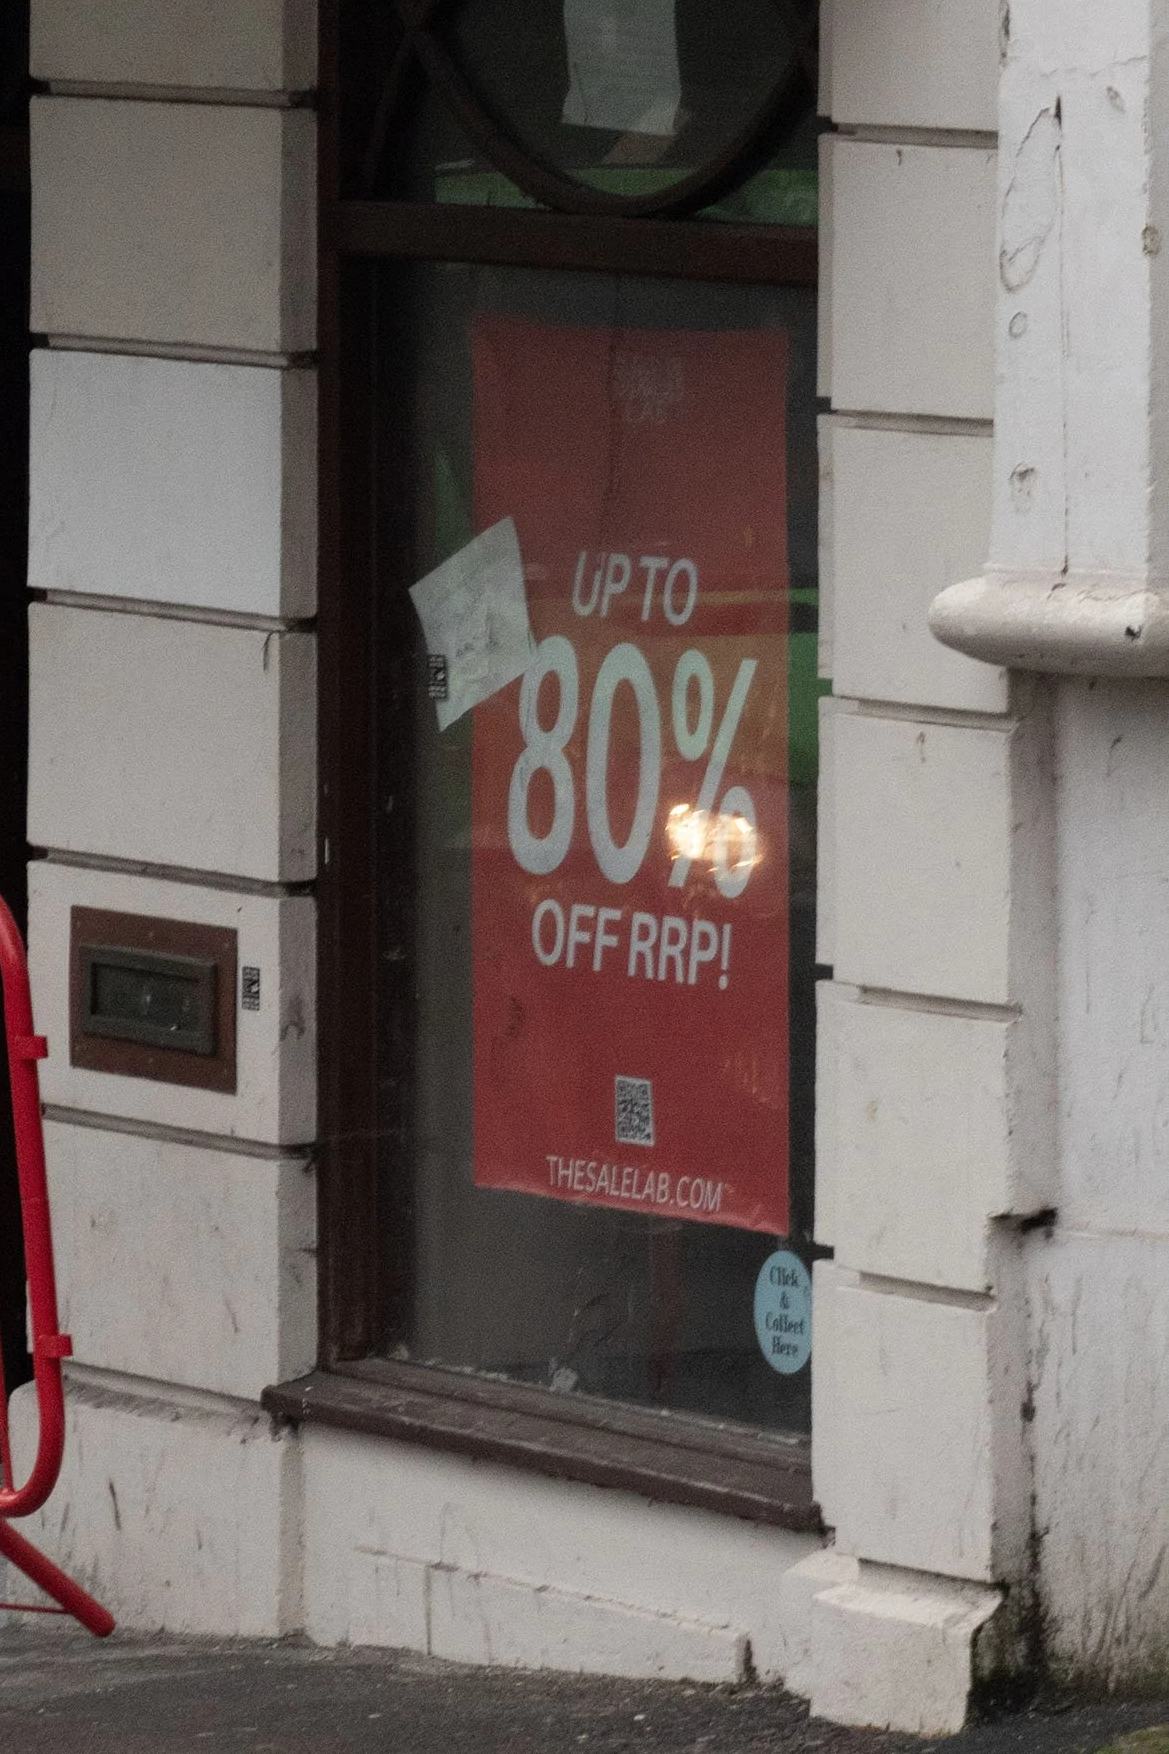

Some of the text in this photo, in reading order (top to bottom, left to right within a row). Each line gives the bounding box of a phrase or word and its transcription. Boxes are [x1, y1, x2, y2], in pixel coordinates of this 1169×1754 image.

[507, 634, 759, 899] 80%
[532, 898, 733, 990] OFF RRP!
[545, 1154, 724, 1213] THESALELAB.COM
[769, 1265, 800, 1289] Click
[765, 1310, 806, 1336] Collect
